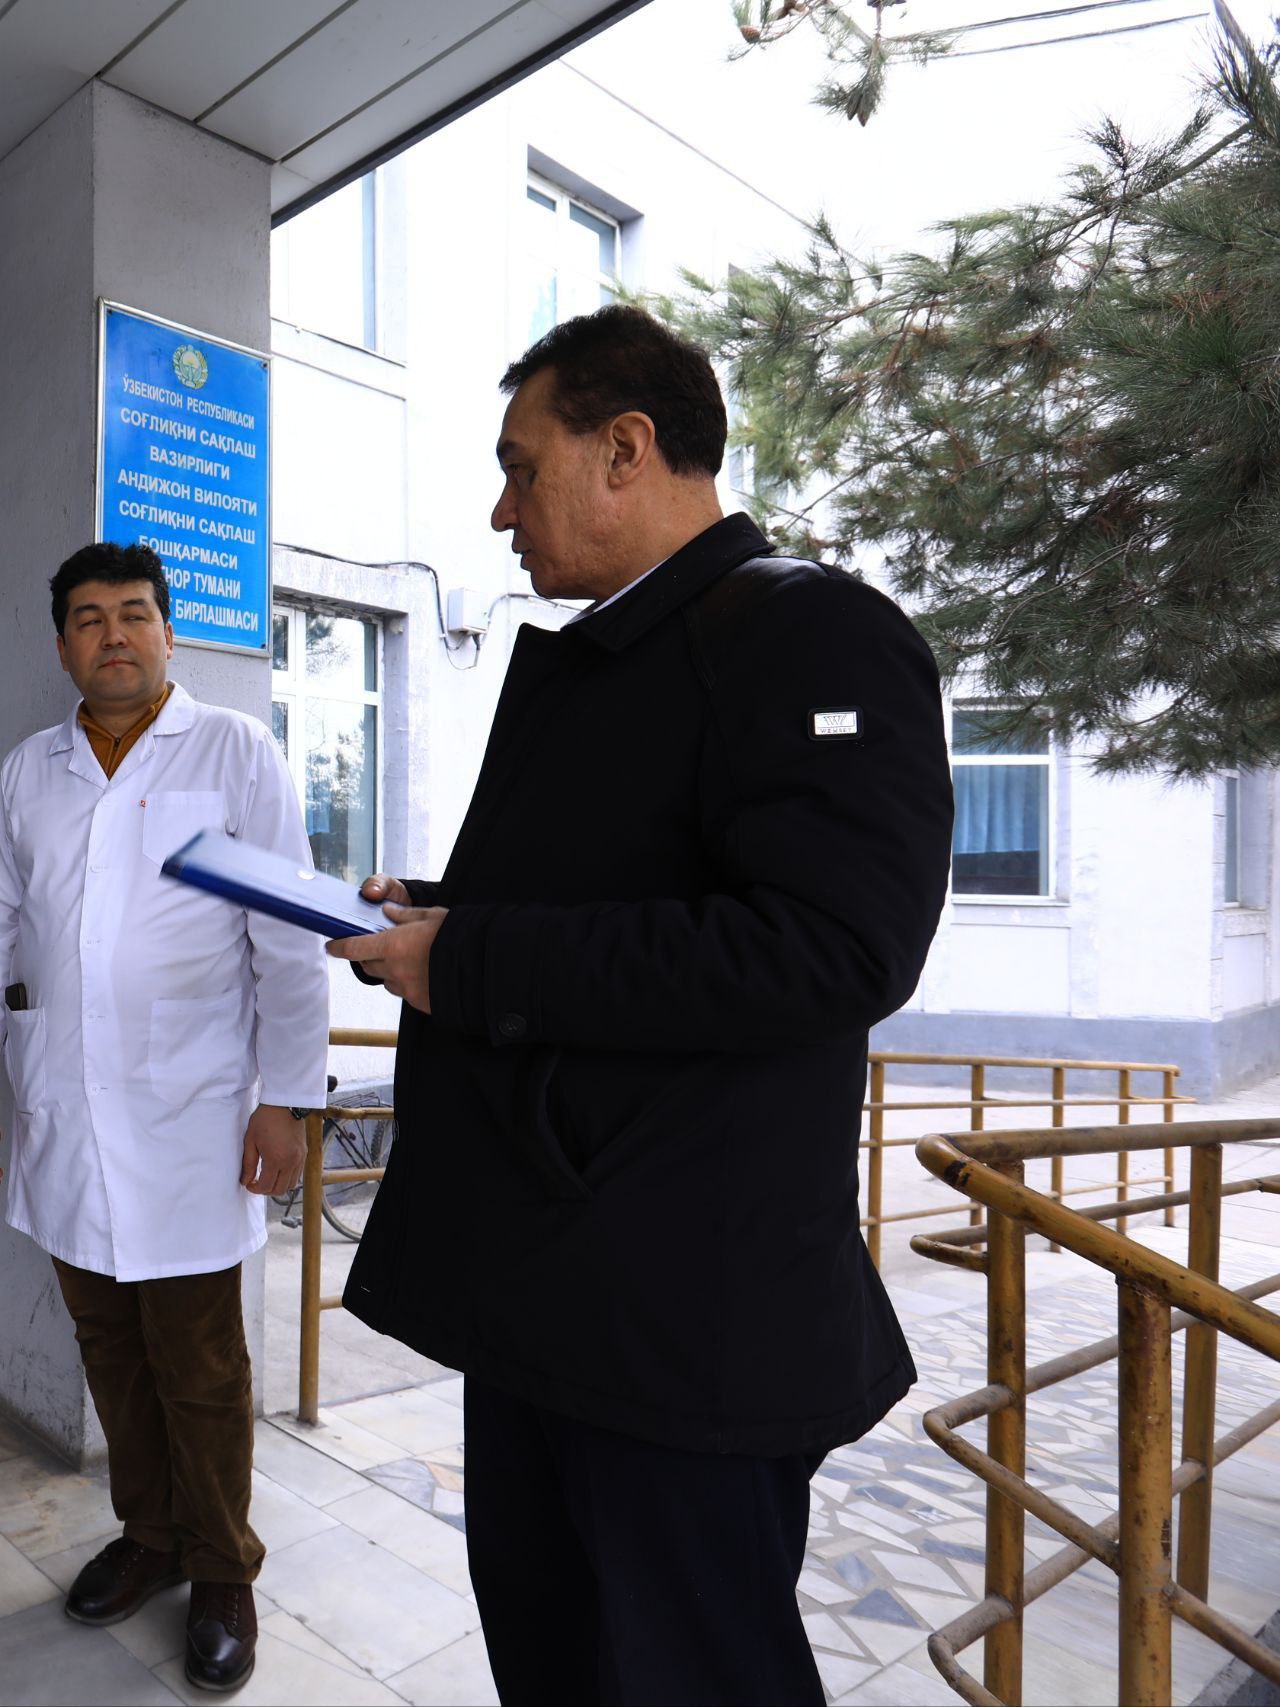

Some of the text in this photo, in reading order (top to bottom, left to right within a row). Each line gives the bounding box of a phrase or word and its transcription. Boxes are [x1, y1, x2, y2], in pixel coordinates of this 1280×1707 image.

[123, 373, 255, 430] ЎЗБЕКИСТОН РЕСПУБЛИКАСИ
[120, 407, 256, 459] СОҒЛИҚНИ САҚЛАШ
[150, 445, 230, 480] ВАЗИРЛИГИ
[117, 469, 257, 516] АНДИЖОН ВИЛОЯТИ
[119, 500, 256, 545] СОҒЛИҚНИ САҚЛАШ
[138, 535, 238, 570] БОШҚАРМАСИ
[161, 565, 241, 600] НОР ТУМАНИ
[175, 598, 258, 632] БИРЛАШМАСИ
